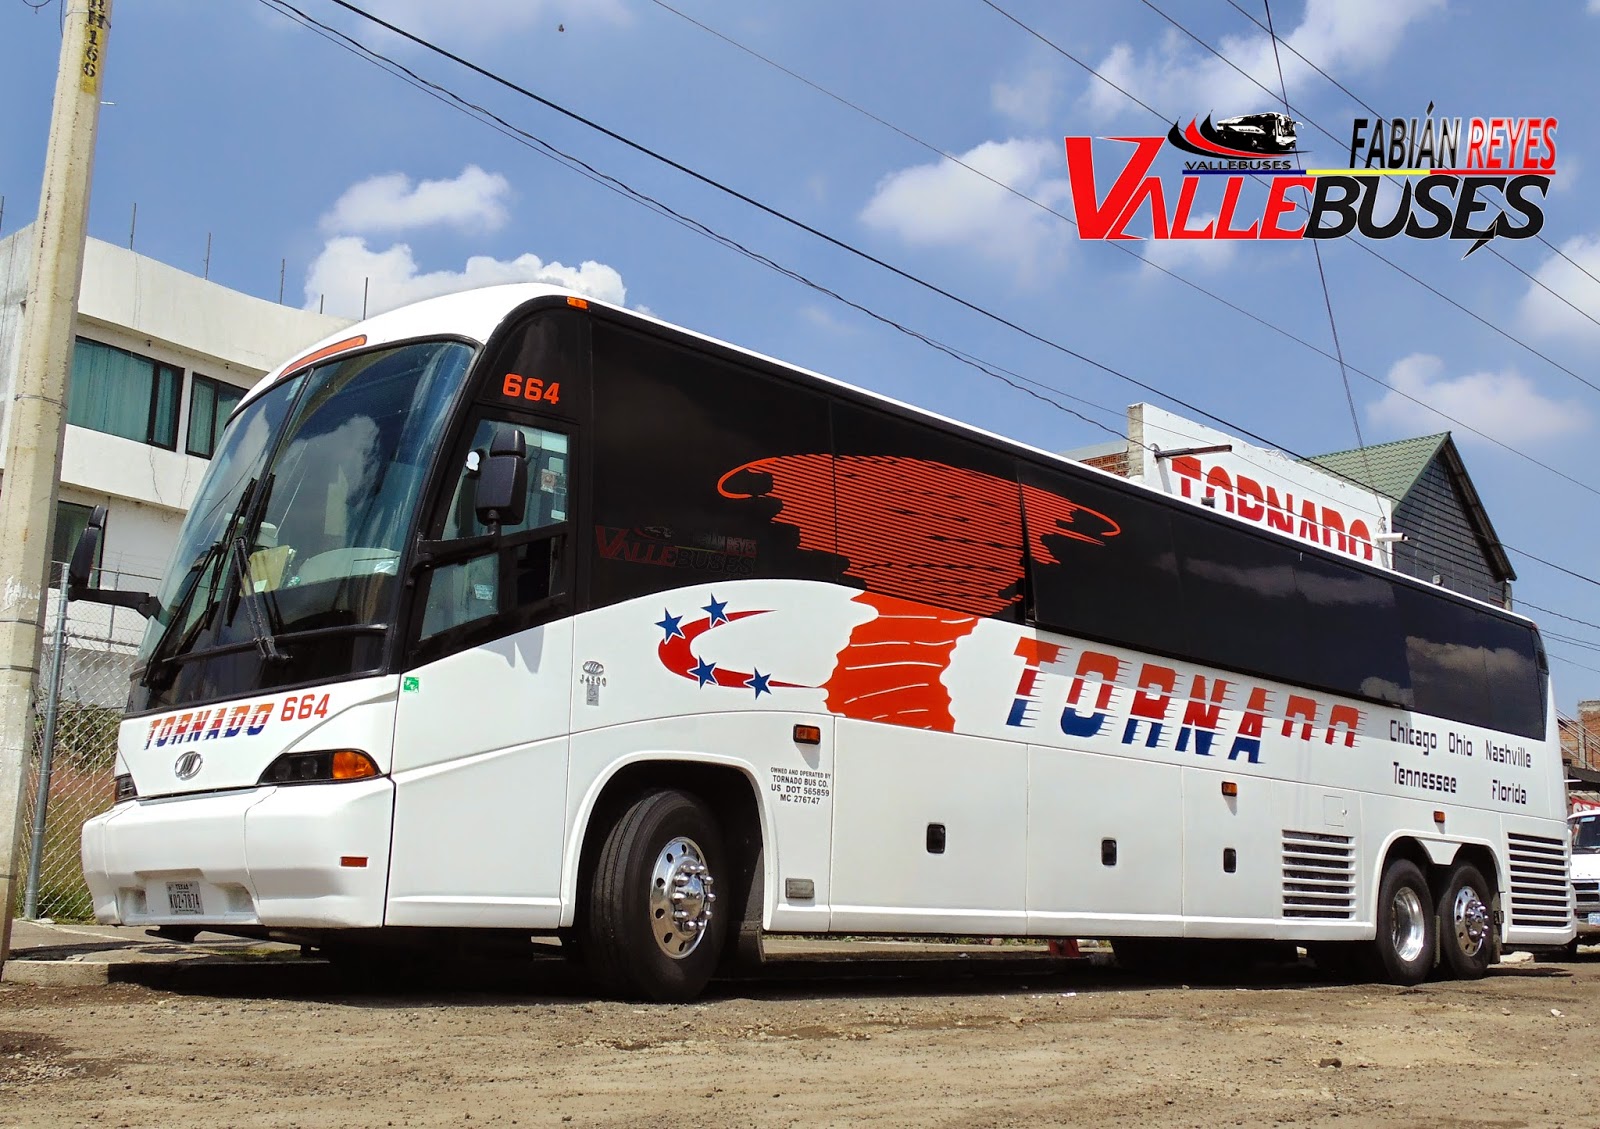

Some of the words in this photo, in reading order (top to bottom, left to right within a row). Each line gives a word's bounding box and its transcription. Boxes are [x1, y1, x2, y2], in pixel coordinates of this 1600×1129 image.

[502, 373, 561, 405] 664
[143, 703, 275, 750] TORNADO
[280, 693, 331, 722] 664
[1390, 719, 1437, 756] Chicago
[1448, 732, 1473, 757] Ohio
[1485, 739, 1532, 769] Nashville
[770, 766, 788, 775] OWNED
[799, 770, 824, 779] OPERATED
[824, 772, 832, 780] BY
[772, 774, 803, 786] TORNADO
[804, 778, 817, 787] BUS
[818, 780, 829, 788] CO.
[1393, 761, 1457, 794] Tennessee
[1492, 779, 1527, 805] Florida
[770, 783, 782, 792] US
[785, 785, 801, 794] DOT
[803, 787, 830, 797] 565859
[780, 793, 792, 802] MC
[793, 795, 821, 805] 276747
[175, 883, 190, 891] TEXAS
